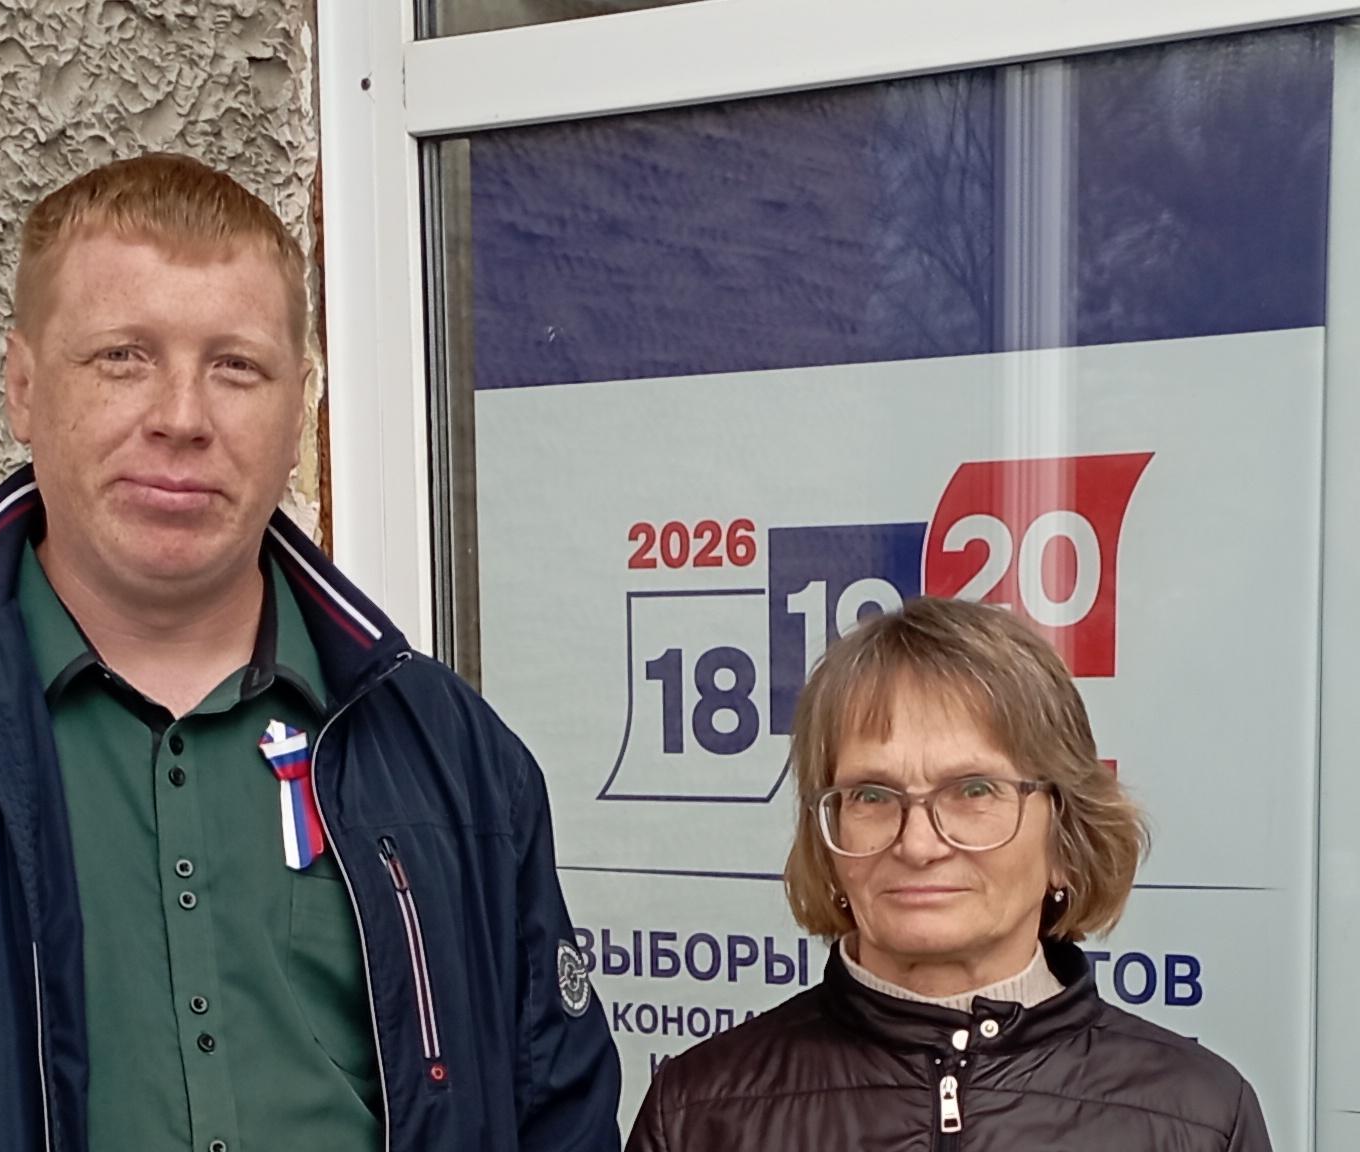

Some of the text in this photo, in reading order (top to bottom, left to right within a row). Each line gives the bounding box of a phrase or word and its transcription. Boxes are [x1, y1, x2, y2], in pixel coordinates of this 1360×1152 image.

[627, 518, 757, 570] 2026
[939, 509, 1103, 629] 20
[645, 646, 760, 757] 18
